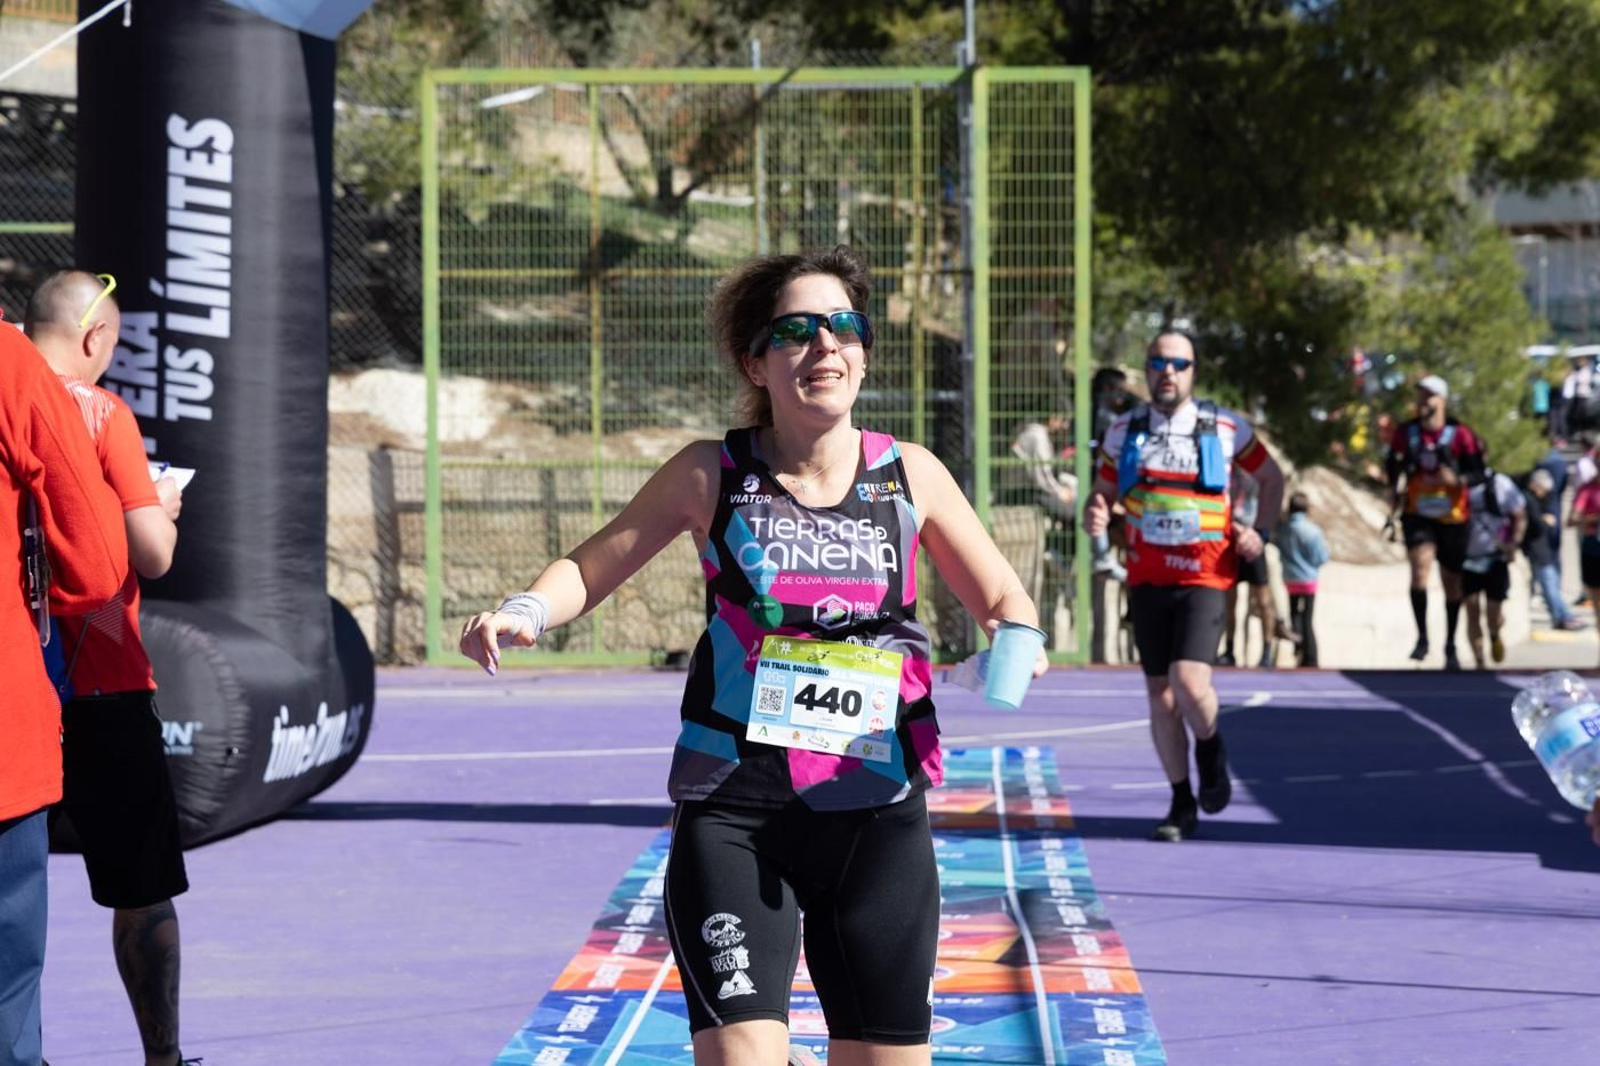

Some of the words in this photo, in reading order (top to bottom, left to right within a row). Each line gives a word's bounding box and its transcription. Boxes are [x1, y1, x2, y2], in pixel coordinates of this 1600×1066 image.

[149, 113, 235, 339] LÍMITES
[164, 345, 214, 422] TUS
[730, 494, 773, 504] VIATOR
[780, 576, 793, 585] DE
[795, 576, 824, 585] OLIVA
[824, 576, 860, 586] VIRGEN
[861, 577, 888, 586] EXTRA
[854, 601, 875, 612] PACO
[760, 660, 770, 668] VII
[771, 662, 791, 671] TRAIL
[792, 665, 830, 676] SOLIDARIO
[793, 683, 863, 717] 440
